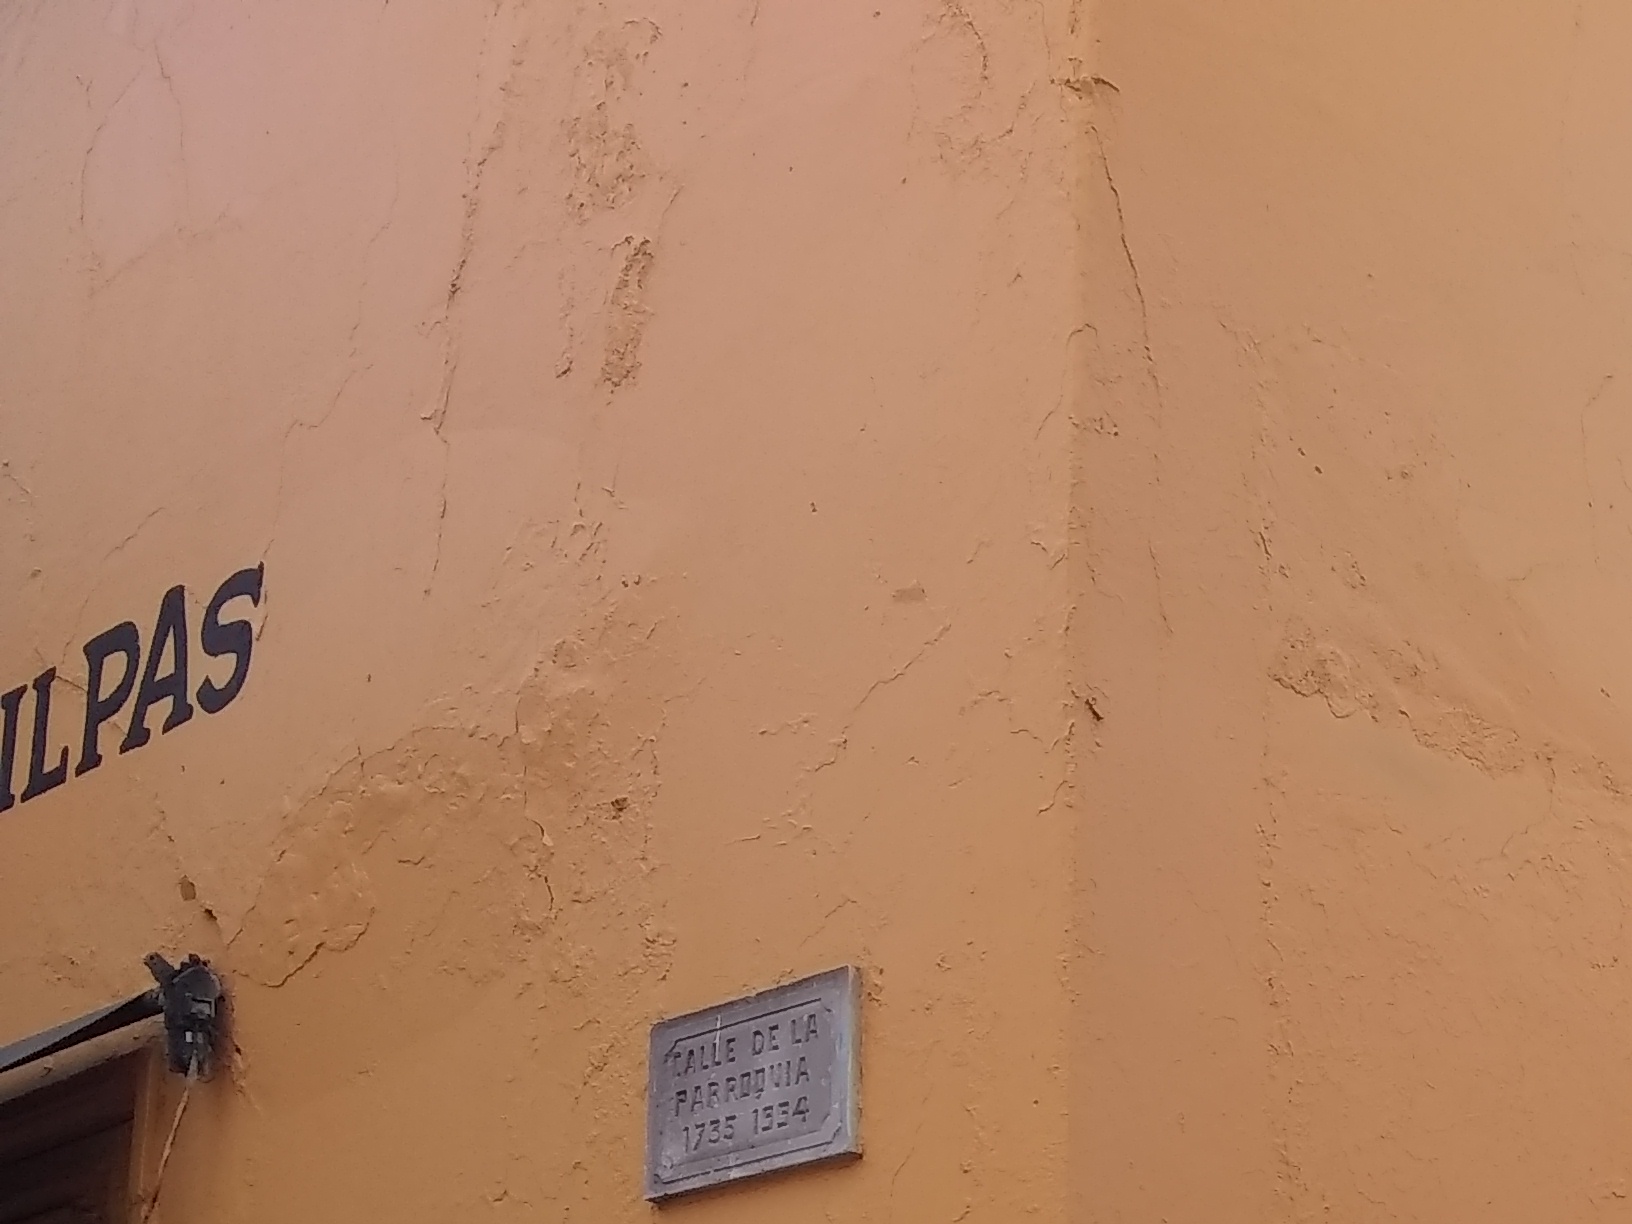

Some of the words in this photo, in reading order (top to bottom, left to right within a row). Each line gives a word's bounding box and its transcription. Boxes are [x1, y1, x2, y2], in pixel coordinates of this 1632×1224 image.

[672, 1038, 736, 1077] CALLE
[752, 1025, 780, 1057] DE
[791, 1013, 819, 1045] LA
[674, 1056, 810, 1117] PARROQUIA
[682, 1114, 737, 1153] 1735
